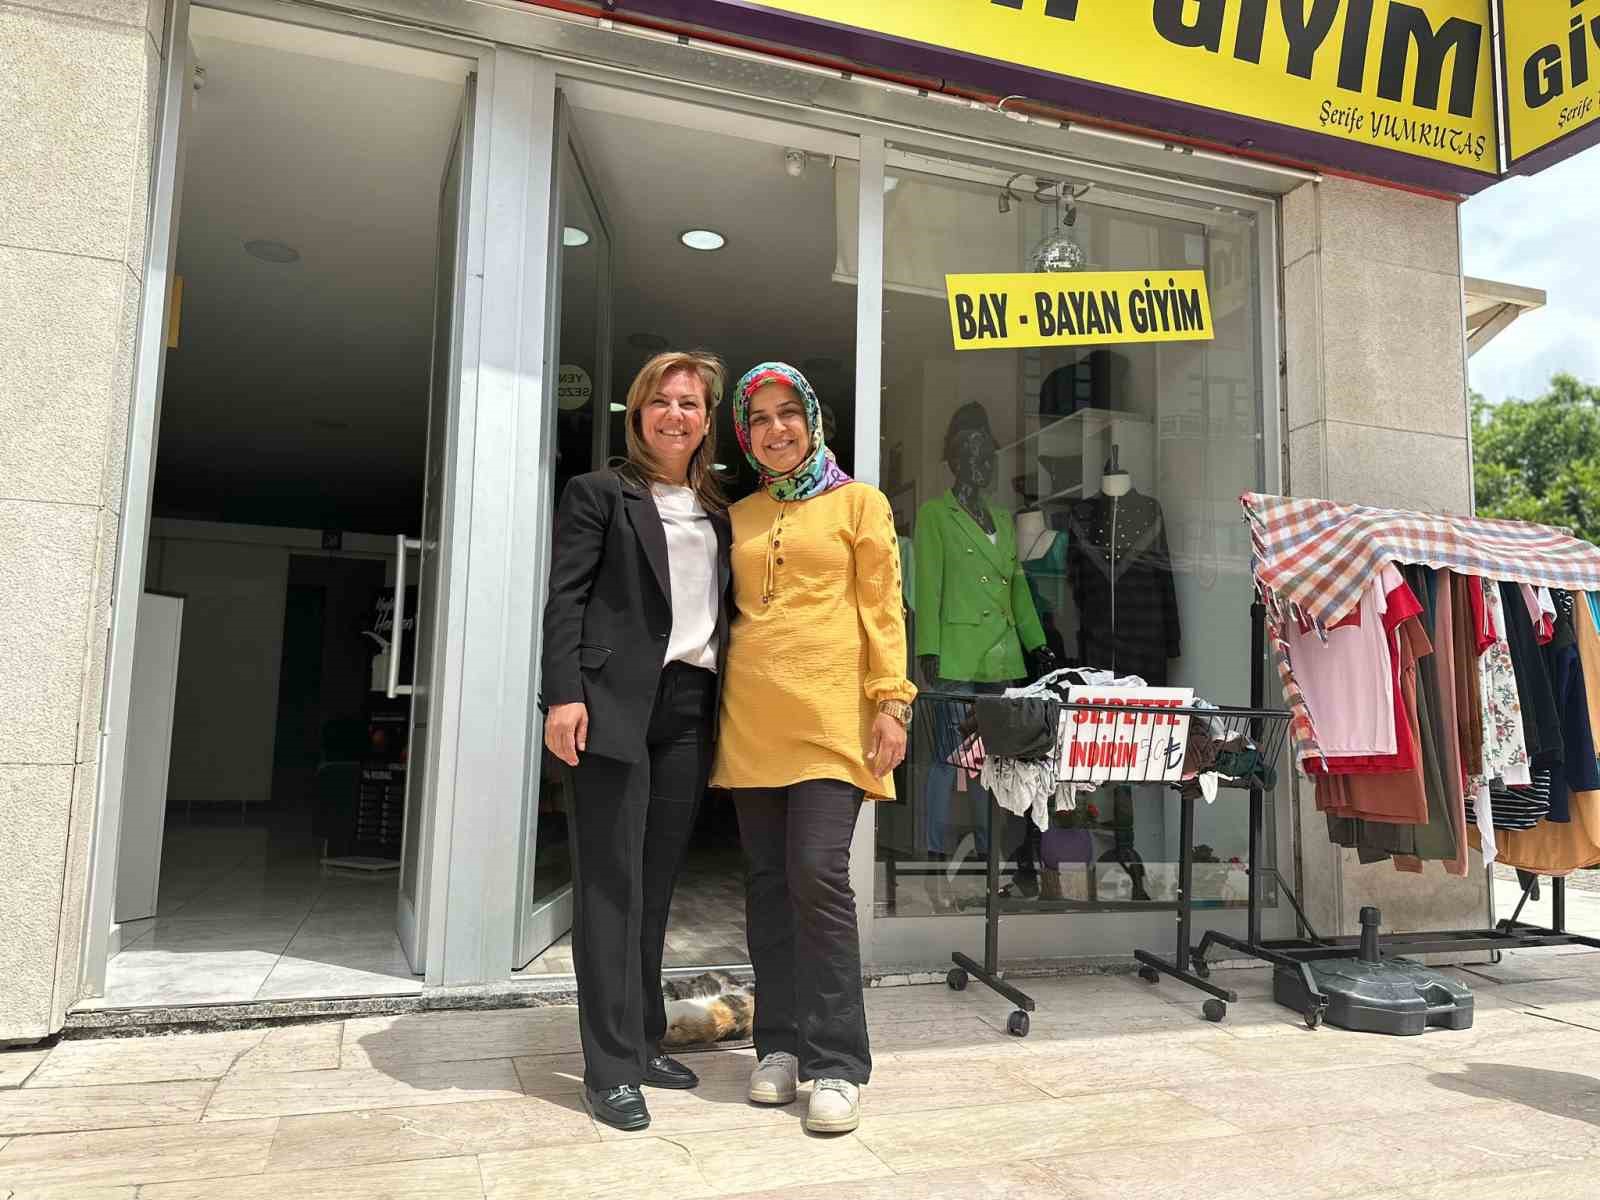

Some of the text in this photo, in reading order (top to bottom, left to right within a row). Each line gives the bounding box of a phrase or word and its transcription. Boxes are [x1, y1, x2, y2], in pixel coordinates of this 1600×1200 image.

[1319, 99, 1486, 161] Şerife YUMRUTAŞ
[955, 292, 1008, 340] BAY
[1034, 290, 1123, 337] BAYAN
[1128, 278, 1204, 334] GİYİM
[1072, 697, 1183, 726] SEPETTE
[1069, 734, 1138, 768] İNDİRİM
